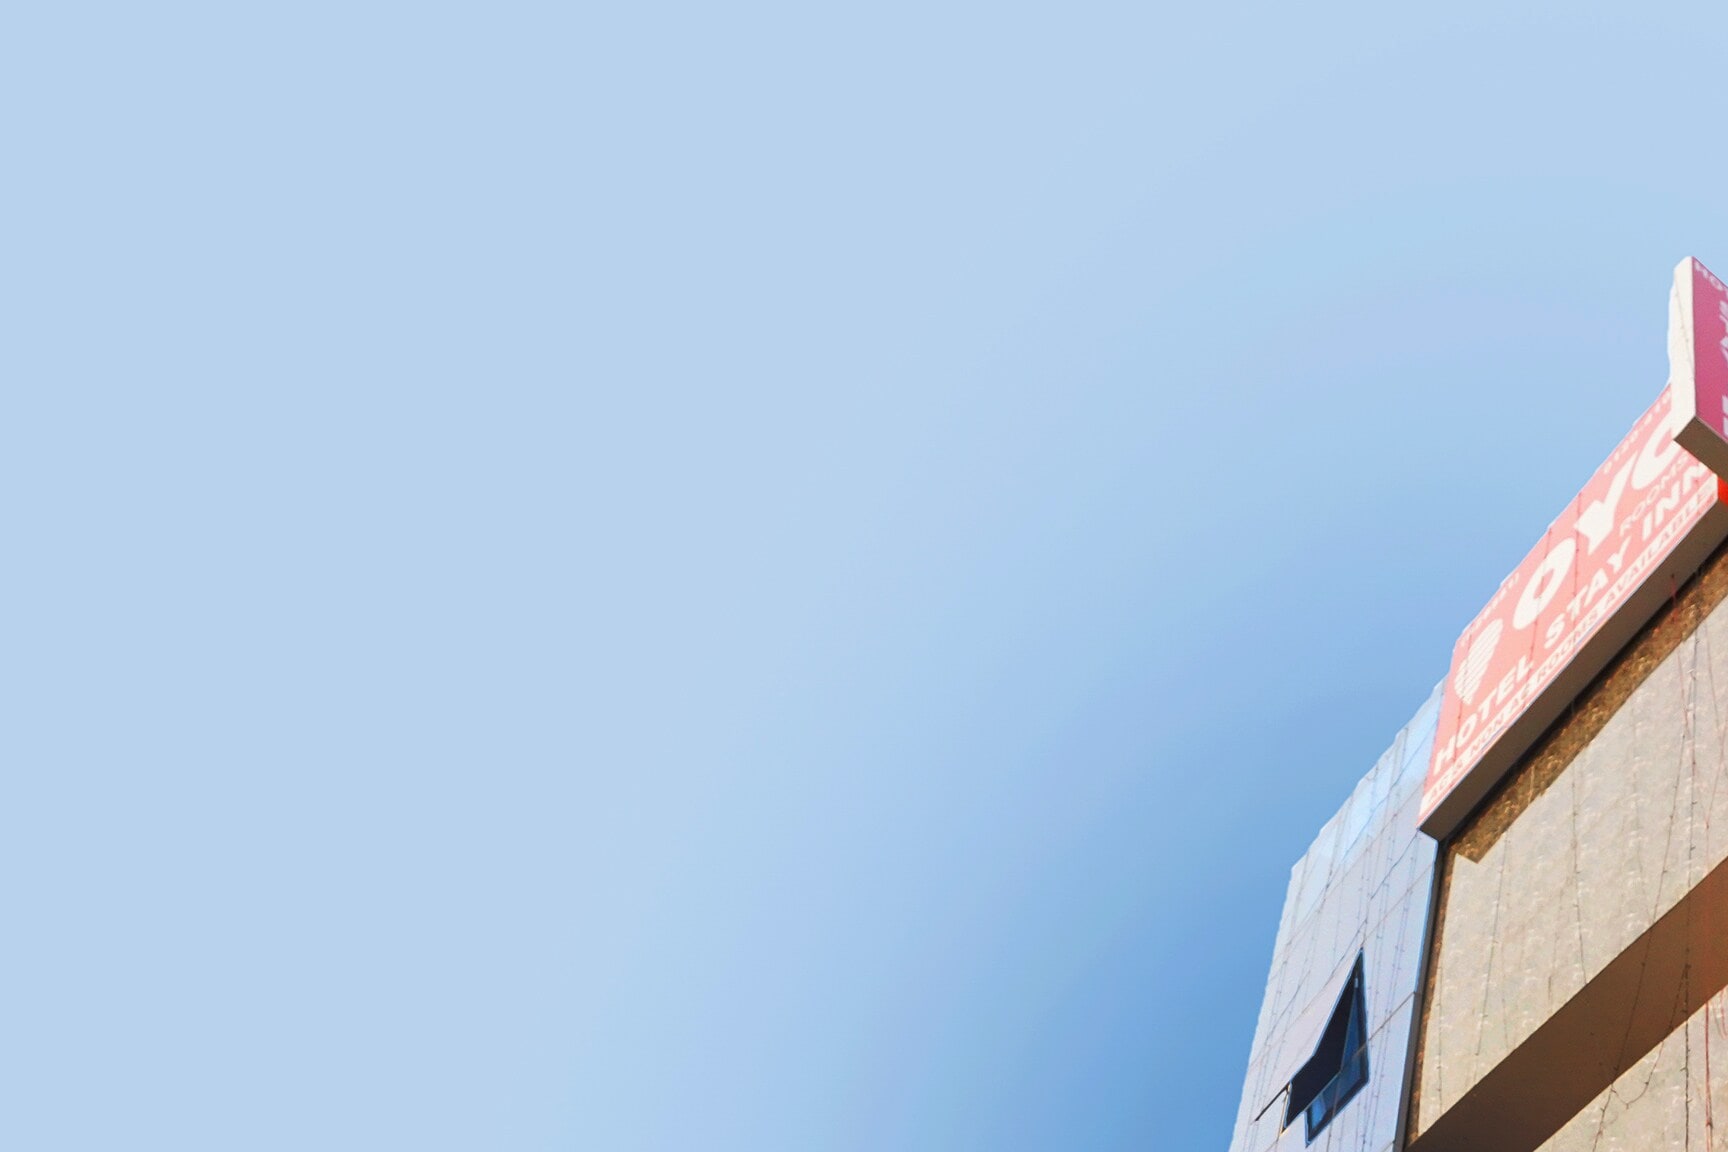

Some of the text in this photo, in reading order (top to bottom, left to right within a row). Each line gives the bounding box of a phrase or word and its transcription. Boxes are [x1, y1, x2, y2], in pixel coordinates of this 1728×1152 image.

[1433, 655, 1533, 776] HOTEL
[1544, 536, 1632, 649] STAY
[1642, 463, 1708, 541] INN
[1604, 491, 1702, 608] AVAILABLE
